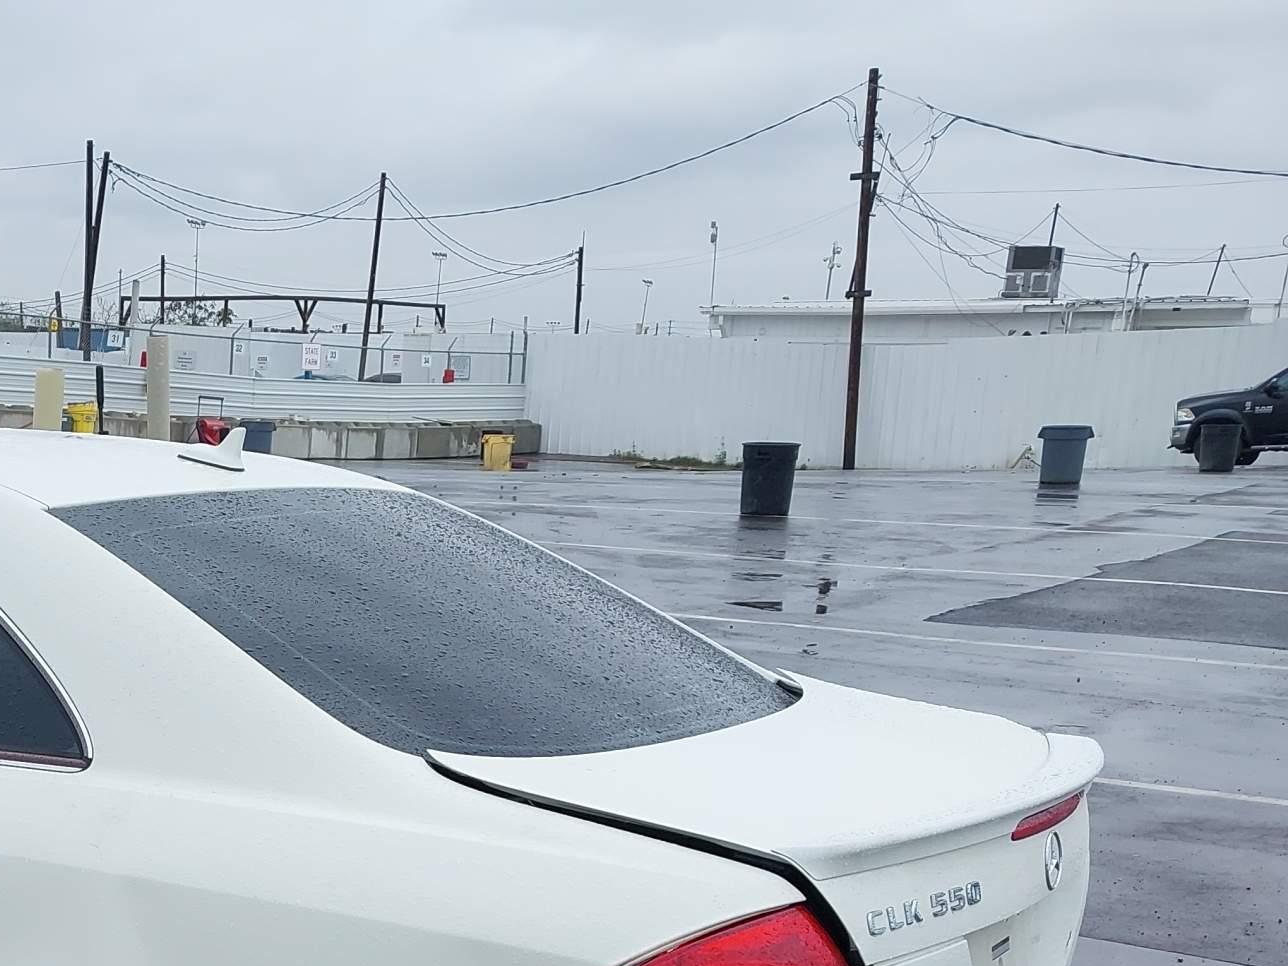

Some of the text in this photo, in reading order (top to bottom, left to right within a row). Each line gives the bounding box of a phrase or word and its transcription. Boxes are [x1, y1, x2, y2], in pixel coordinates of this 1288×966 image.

[111, 334, 120, 344] 31
[304, 347, 319, 355] STATE
[329, 351, 337, 359] 33
[304, 358, 318, 366] FARM
[866, 881, 982, 936] CLK 550
